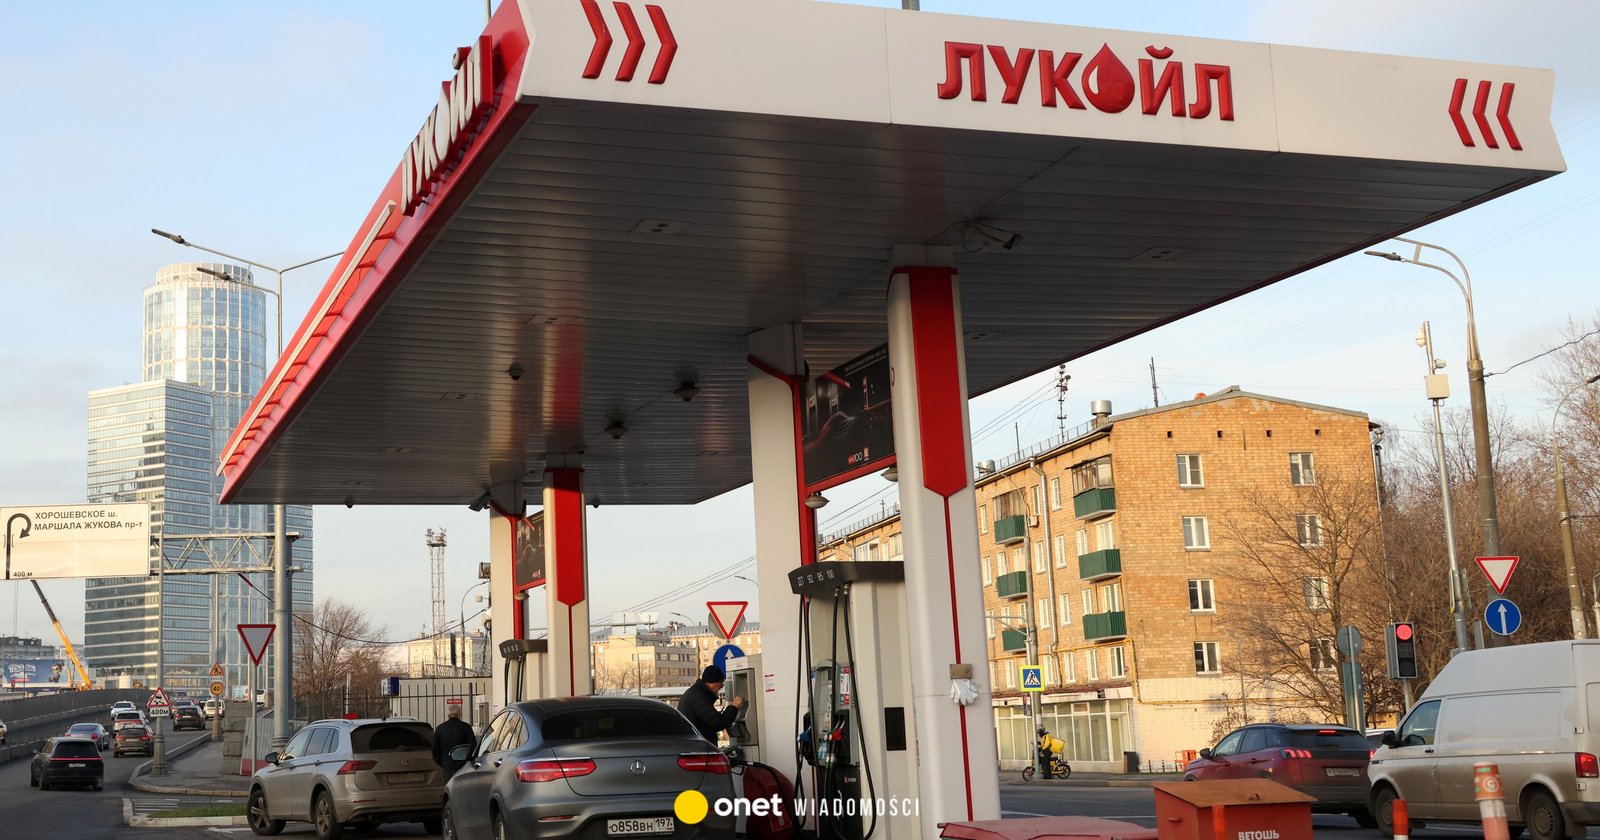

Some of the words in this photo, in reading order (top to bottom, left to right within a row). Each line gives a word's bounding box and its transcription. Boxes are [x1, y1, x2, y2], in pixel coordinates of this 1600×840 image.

[937, 41, 1234, 121] ЛУКОЙЛ
[35, 510, 105, 520] ХОРОШЕВСКОЕ
[34, 522, 82, 531] МАРШАЛА
[84, 521, 123, 529] ЖУКОВА
[125, 521, 143, 530] пр-т
[807, 574, 815, 584] 92
[816, 571, 825, 582] 95
[827, 569, 835, 579] 100
[1238, 829, 1280, 840] ВЕТОШЬ
